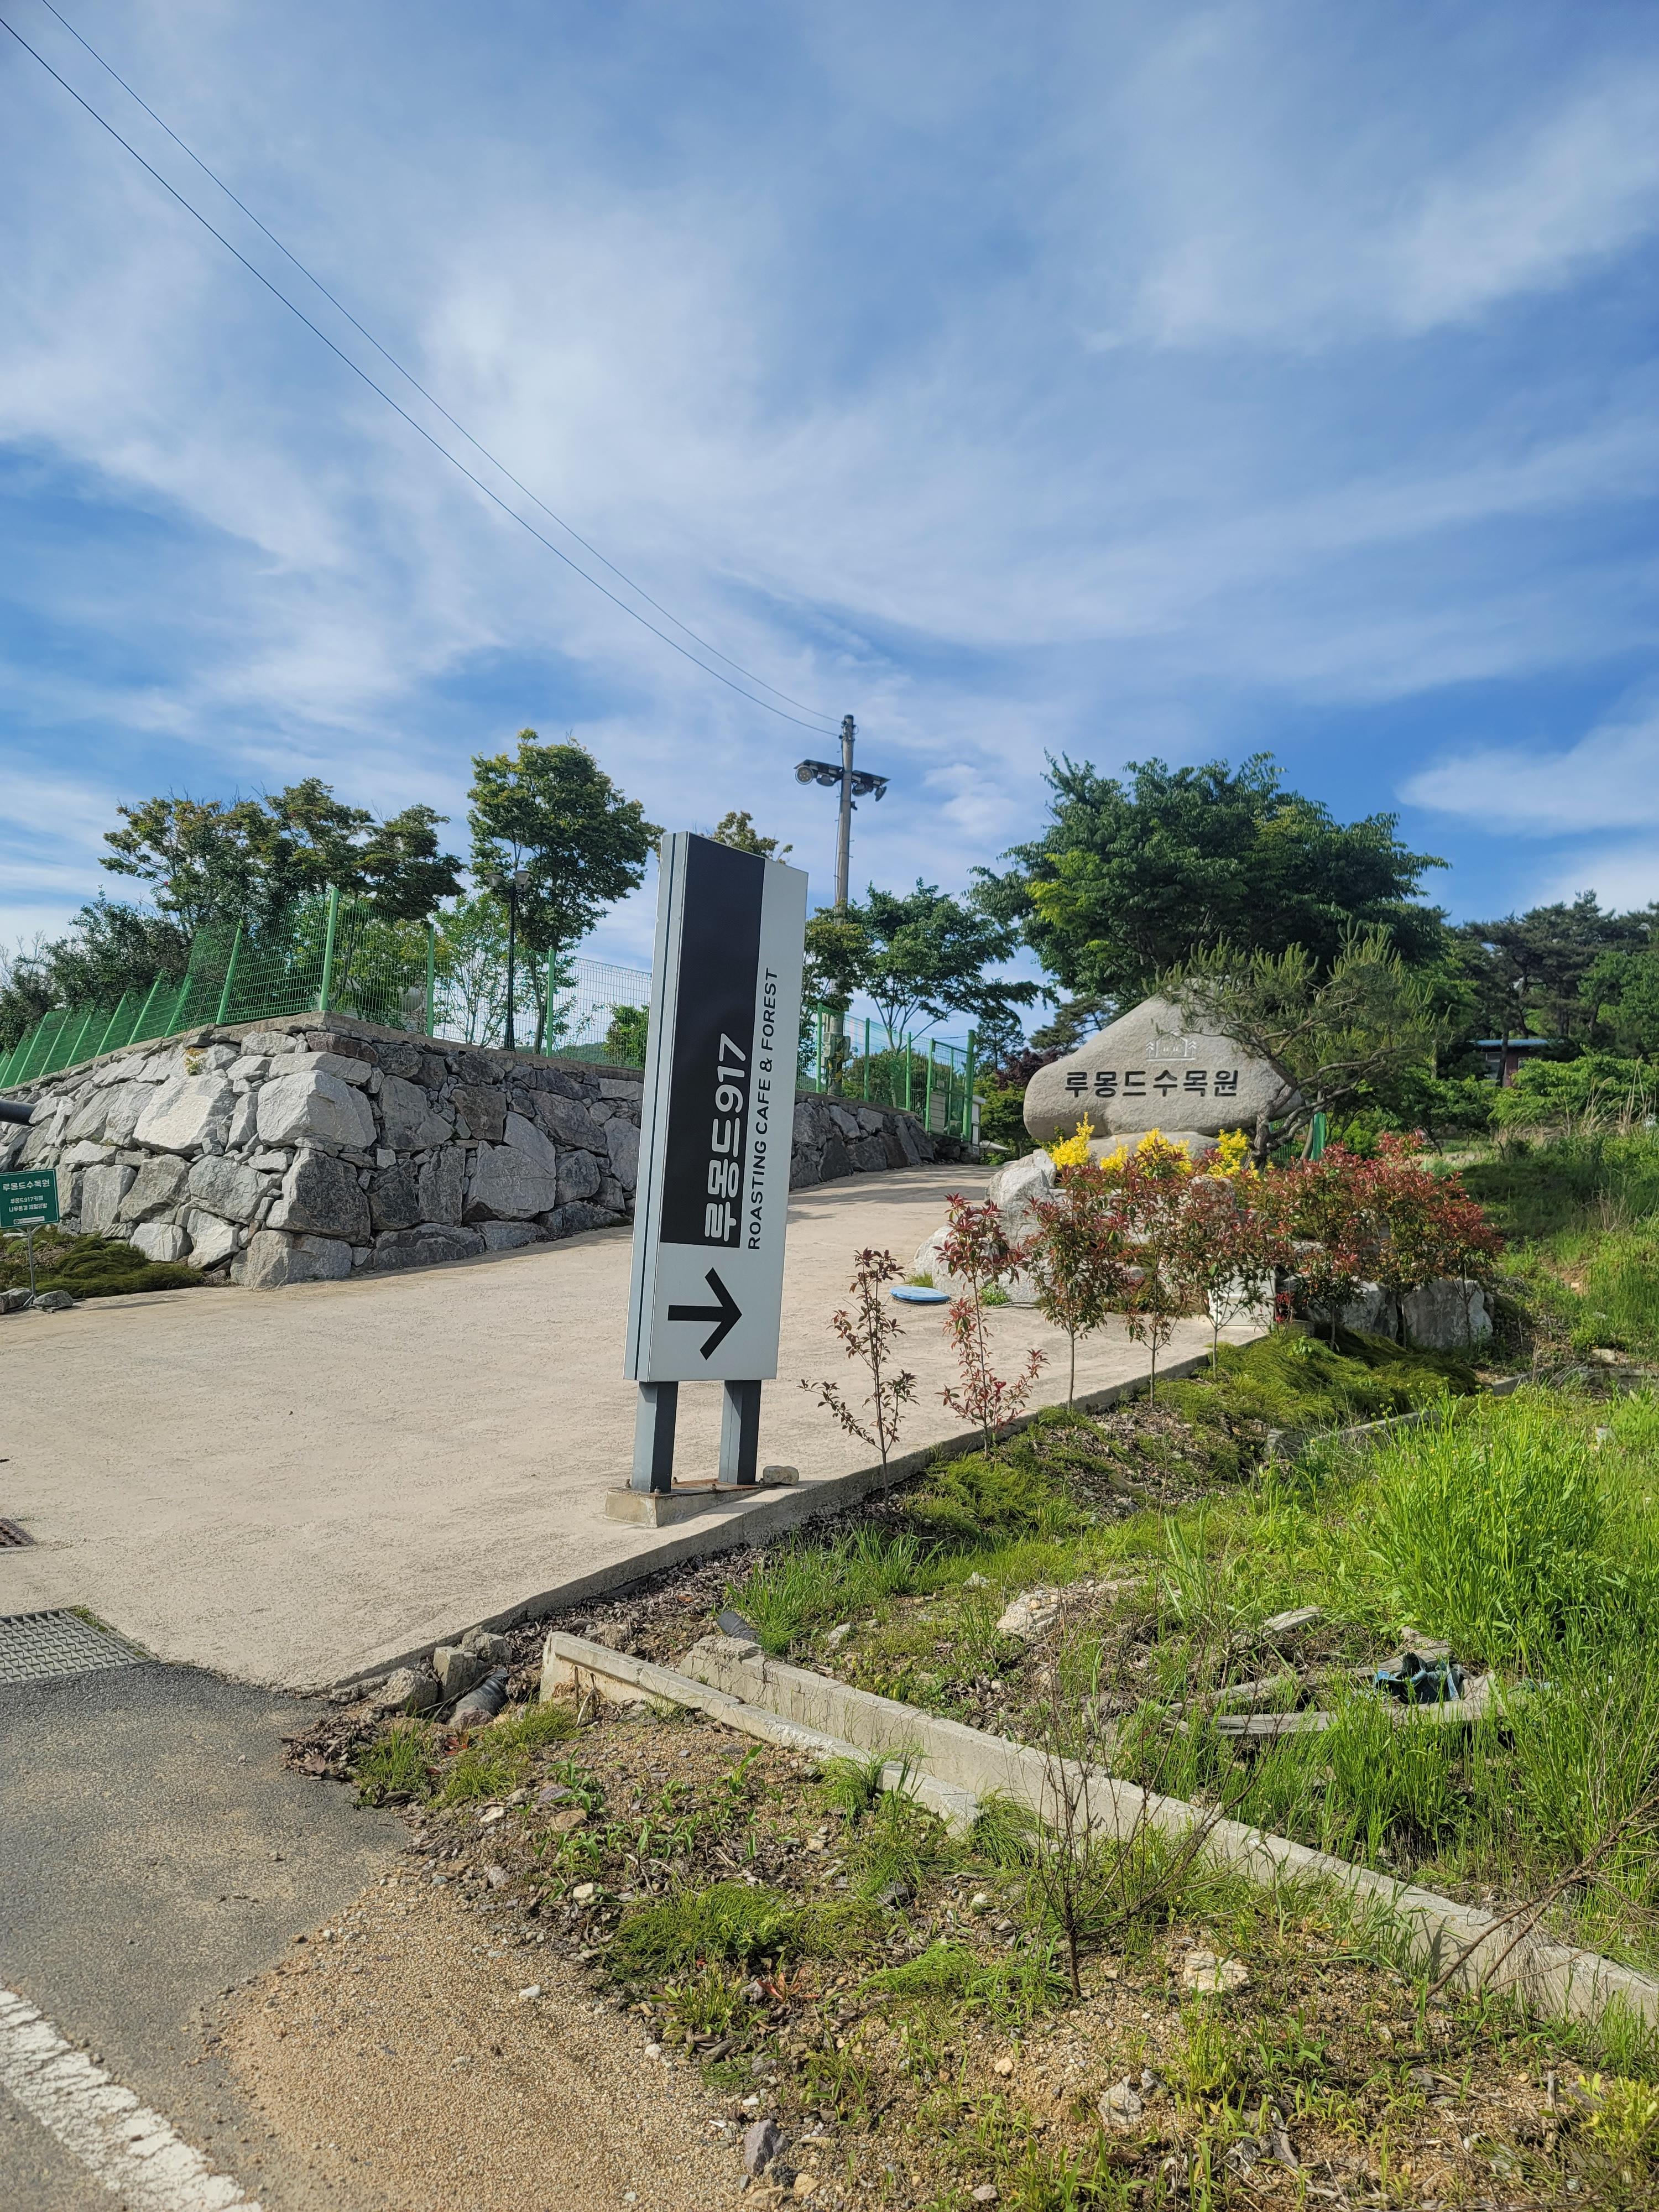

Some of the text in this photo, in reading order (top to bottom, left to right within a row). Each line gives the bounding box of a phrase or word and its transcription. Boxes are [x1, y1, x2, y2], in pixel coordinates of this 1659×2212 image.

[705, 1033, 746, 1243] 루몽드917
[748, 967, 778, 1250] ROASTING CAFE & FOREST
[1065, 1069, 1239, 1098] 루몽드수목원
[2, 1178, 50, 1191] 루몽드수목원
